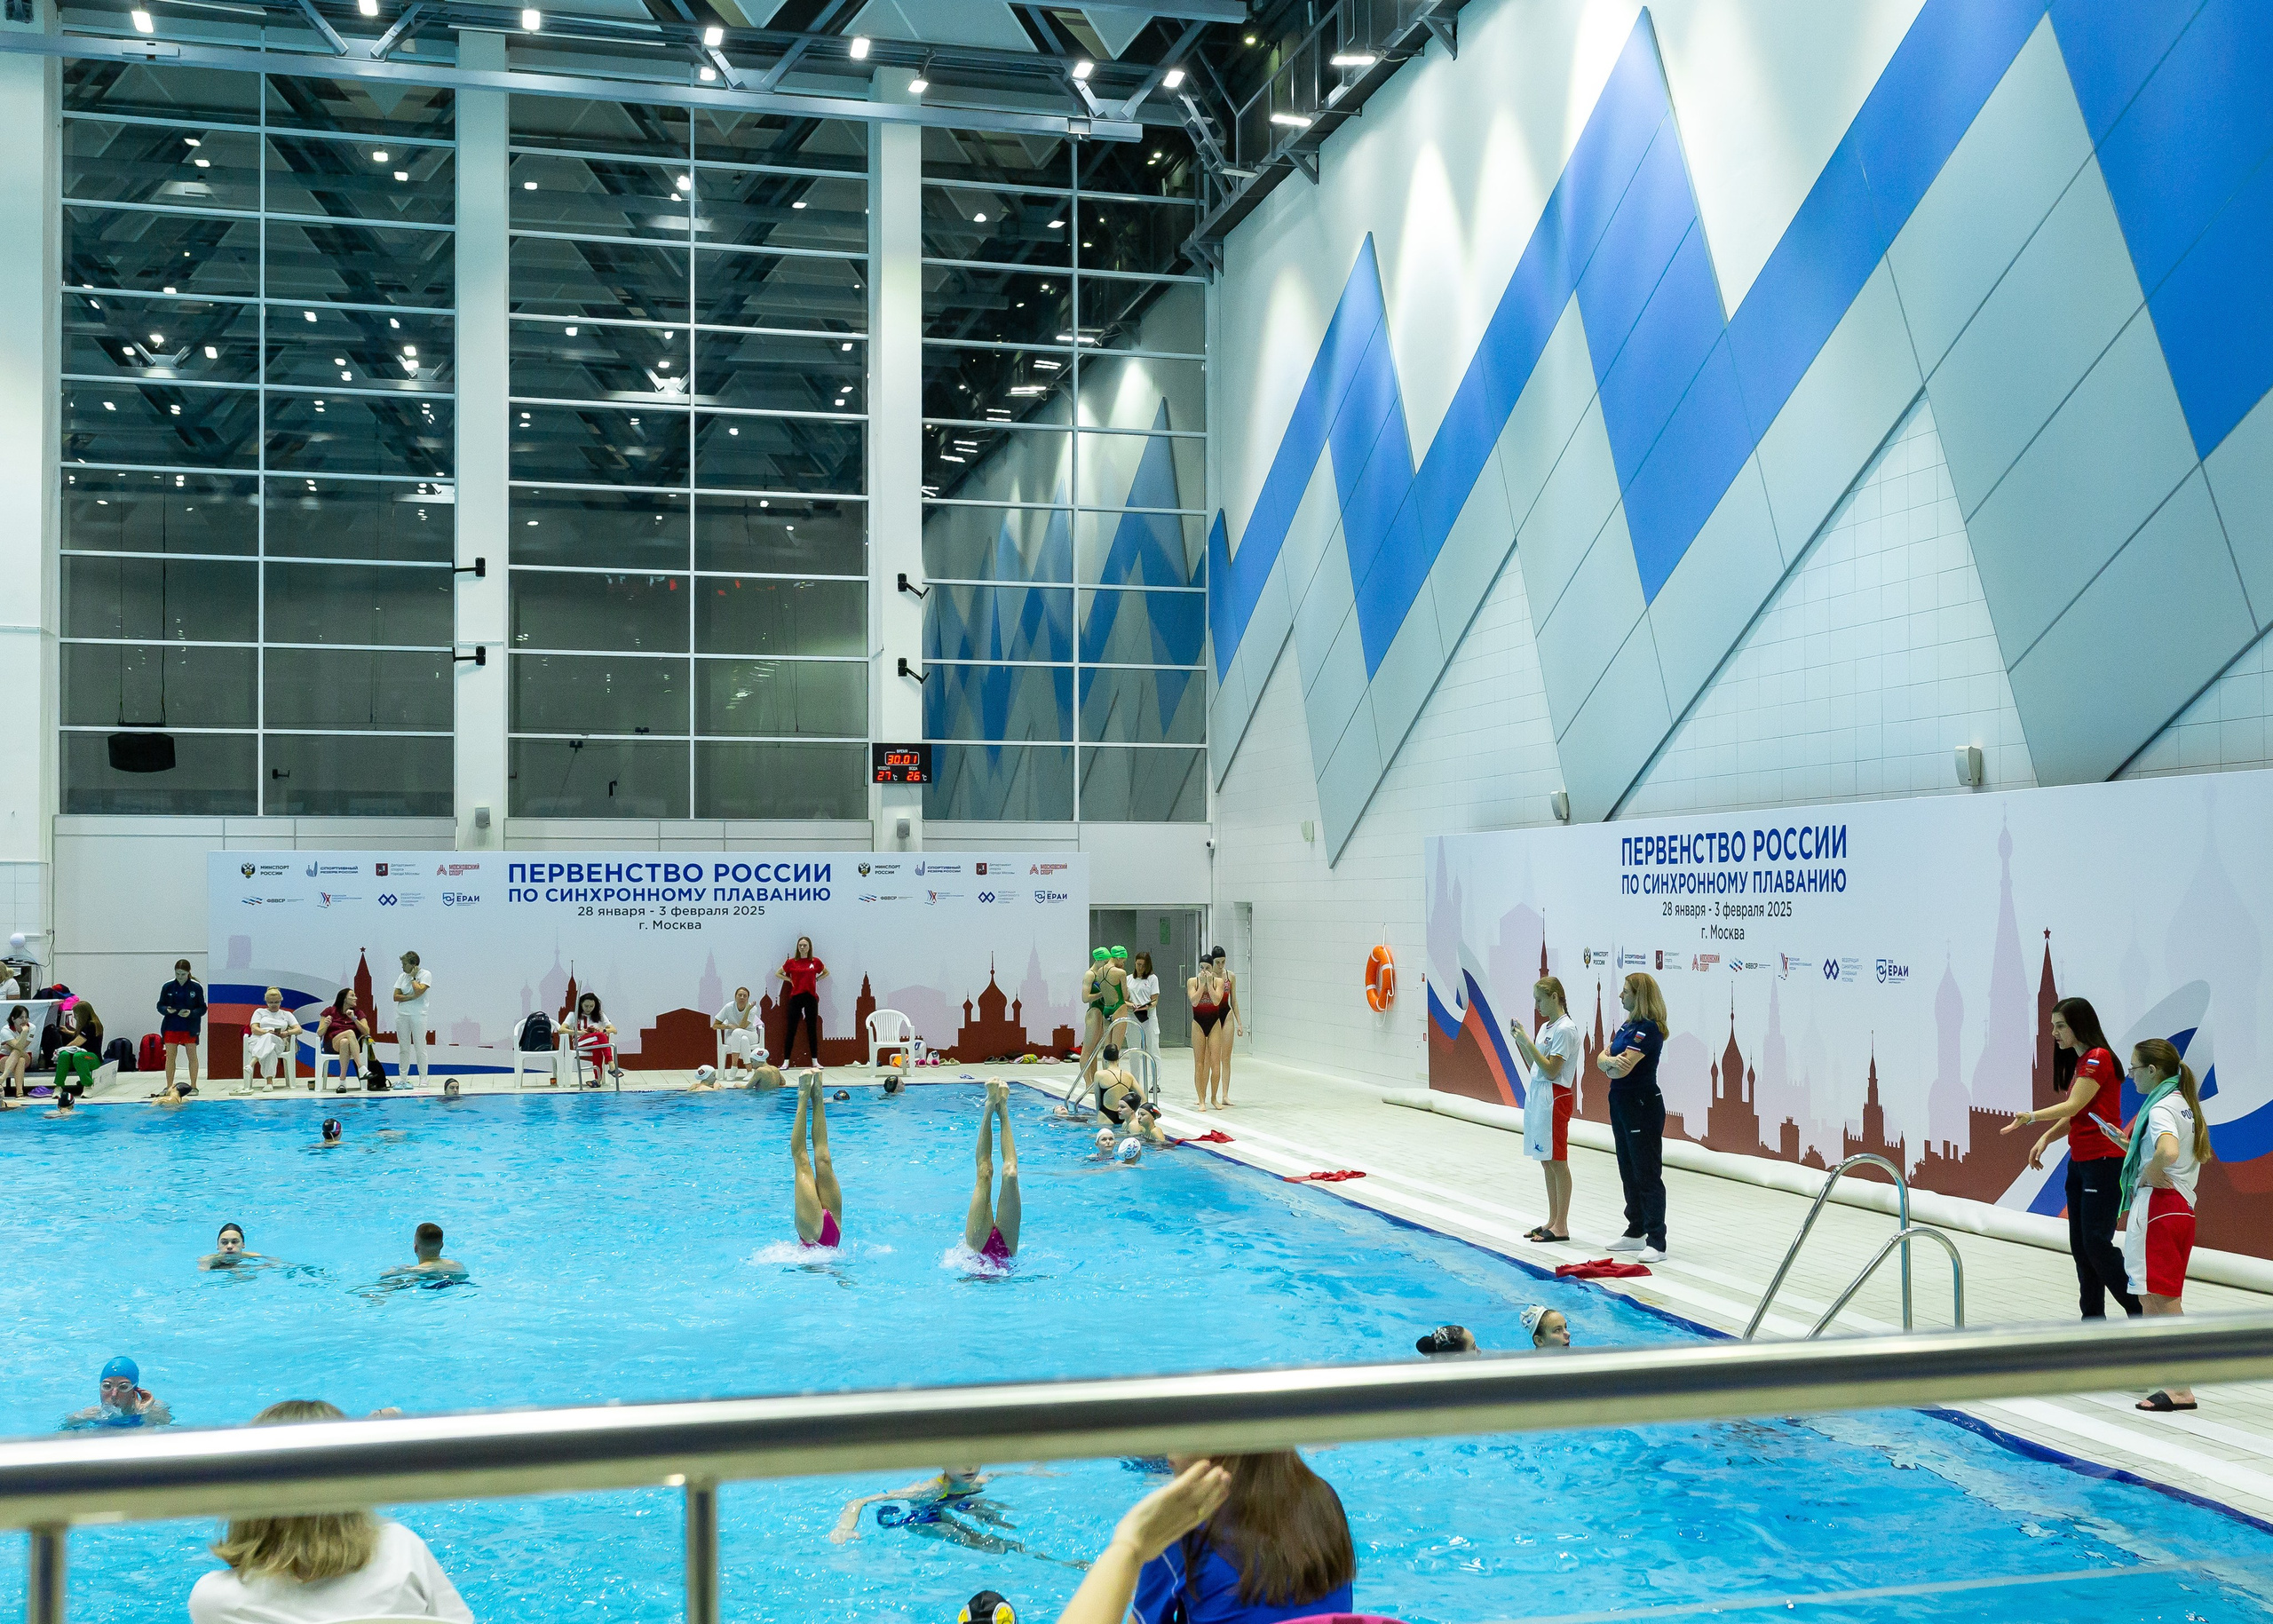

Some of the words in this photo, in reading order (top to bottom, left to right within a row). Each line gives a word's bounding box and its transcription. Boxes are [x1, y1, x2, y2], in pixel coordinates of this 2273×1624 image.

[888, 755, 917, 764] 30.01
[877, 771, 891, 780] 27
[907, 771, 921, 780] 26
[1621, 831, 1746, 866] ПЕРВЕНСТВО
[1754, 825, 1847, 861] РОССИИ
[509, 863, 703, 883] ПЕРВЕНСТВО
[715, 863, 831, 883] РОССИИ
[1622, 874, 1639, 894] ПО
[1643, 872, 1748, 894] СИНХРОННОМУ
[1754, 868, 1846, 893] ПЛАВАНИЮ
[509, 889, 538, 902] ПО
[546, 888, 706, 902] СИНХРОННОМУ
[714, 888, 831, 901] ПЛАВАНИЮ
[578, 907, 593, 915] 28
[598, 907, 645, 917] января
[659, 907, 667, 915] 3
[671, 907, 729, 917] февраля
[733, 906, 765, 915] 2025
[1662, 901, 1672, 915] 28
[1675, 905, 1706, 919] января
[1715, 901, 1720, 916] 3
[1723, 902, 1764, 920] февраля
[1767, 901, 1792, 916] 2025
[653, 920, 701, 930] Москва
[1701, 927, 1707, 939] г.
[1710, 924, 1745, 939] Москва
[1889, 965, 1908, 976] ЕРАИ
